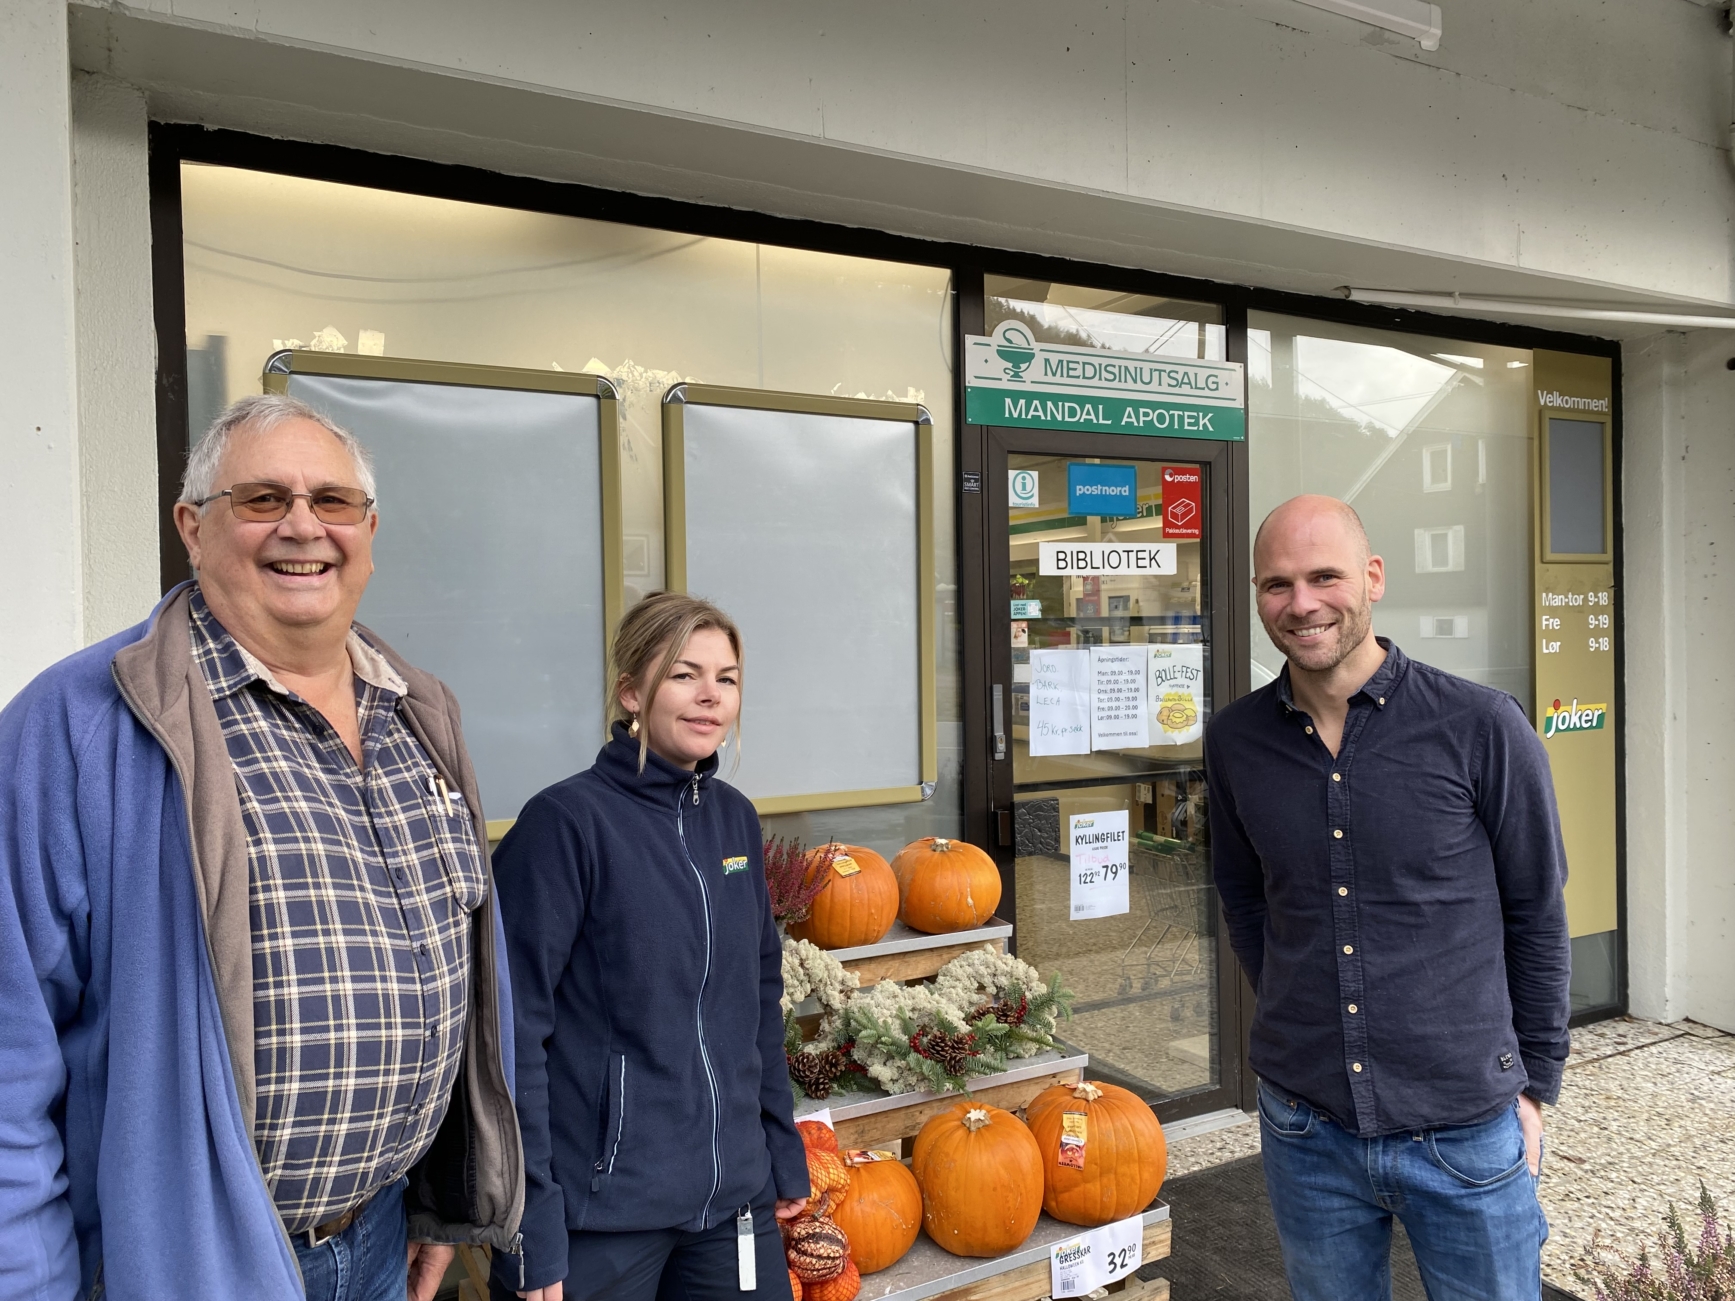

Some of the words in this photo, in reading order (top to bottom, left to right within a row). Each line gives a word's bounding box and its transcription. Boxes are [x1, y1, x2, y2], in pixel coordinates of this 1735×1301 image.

[1043, 357, 1219, 391] MEDISINUTSALG
[1537, 389, 1608, 412] Velkommen!
[1004, 398, 1112, 425] MANDAL
[1121, 406, 1214, 431] APOTEK
[1174, 474, 1199, 483] posten
[1076, 484, 1129, 496] postnord
[1056, 549, 1161, 570] BIBLIOTEK
[1542, 591, 1584, 606] Man-tor
[1588, 591, 1608, 606] 9-18
[1542, 615, 1561, 630] Fre
[1588, 614, 1609, 629] 9-19
[1542, 638, 1561, 653] Lør
[1589, 637, 1609, 651] 9-18
[1546, 698, 1603, 739] joker
[1037, 720, 1049, 737] 45
[1075, 830, 1125, 846] KYLLINGFILET
[724, 857, 747, 875] joker
[1075, 854, 1110, 864] Tilbud
[1059, 1245, 1091, 1265] GRESSKAR
